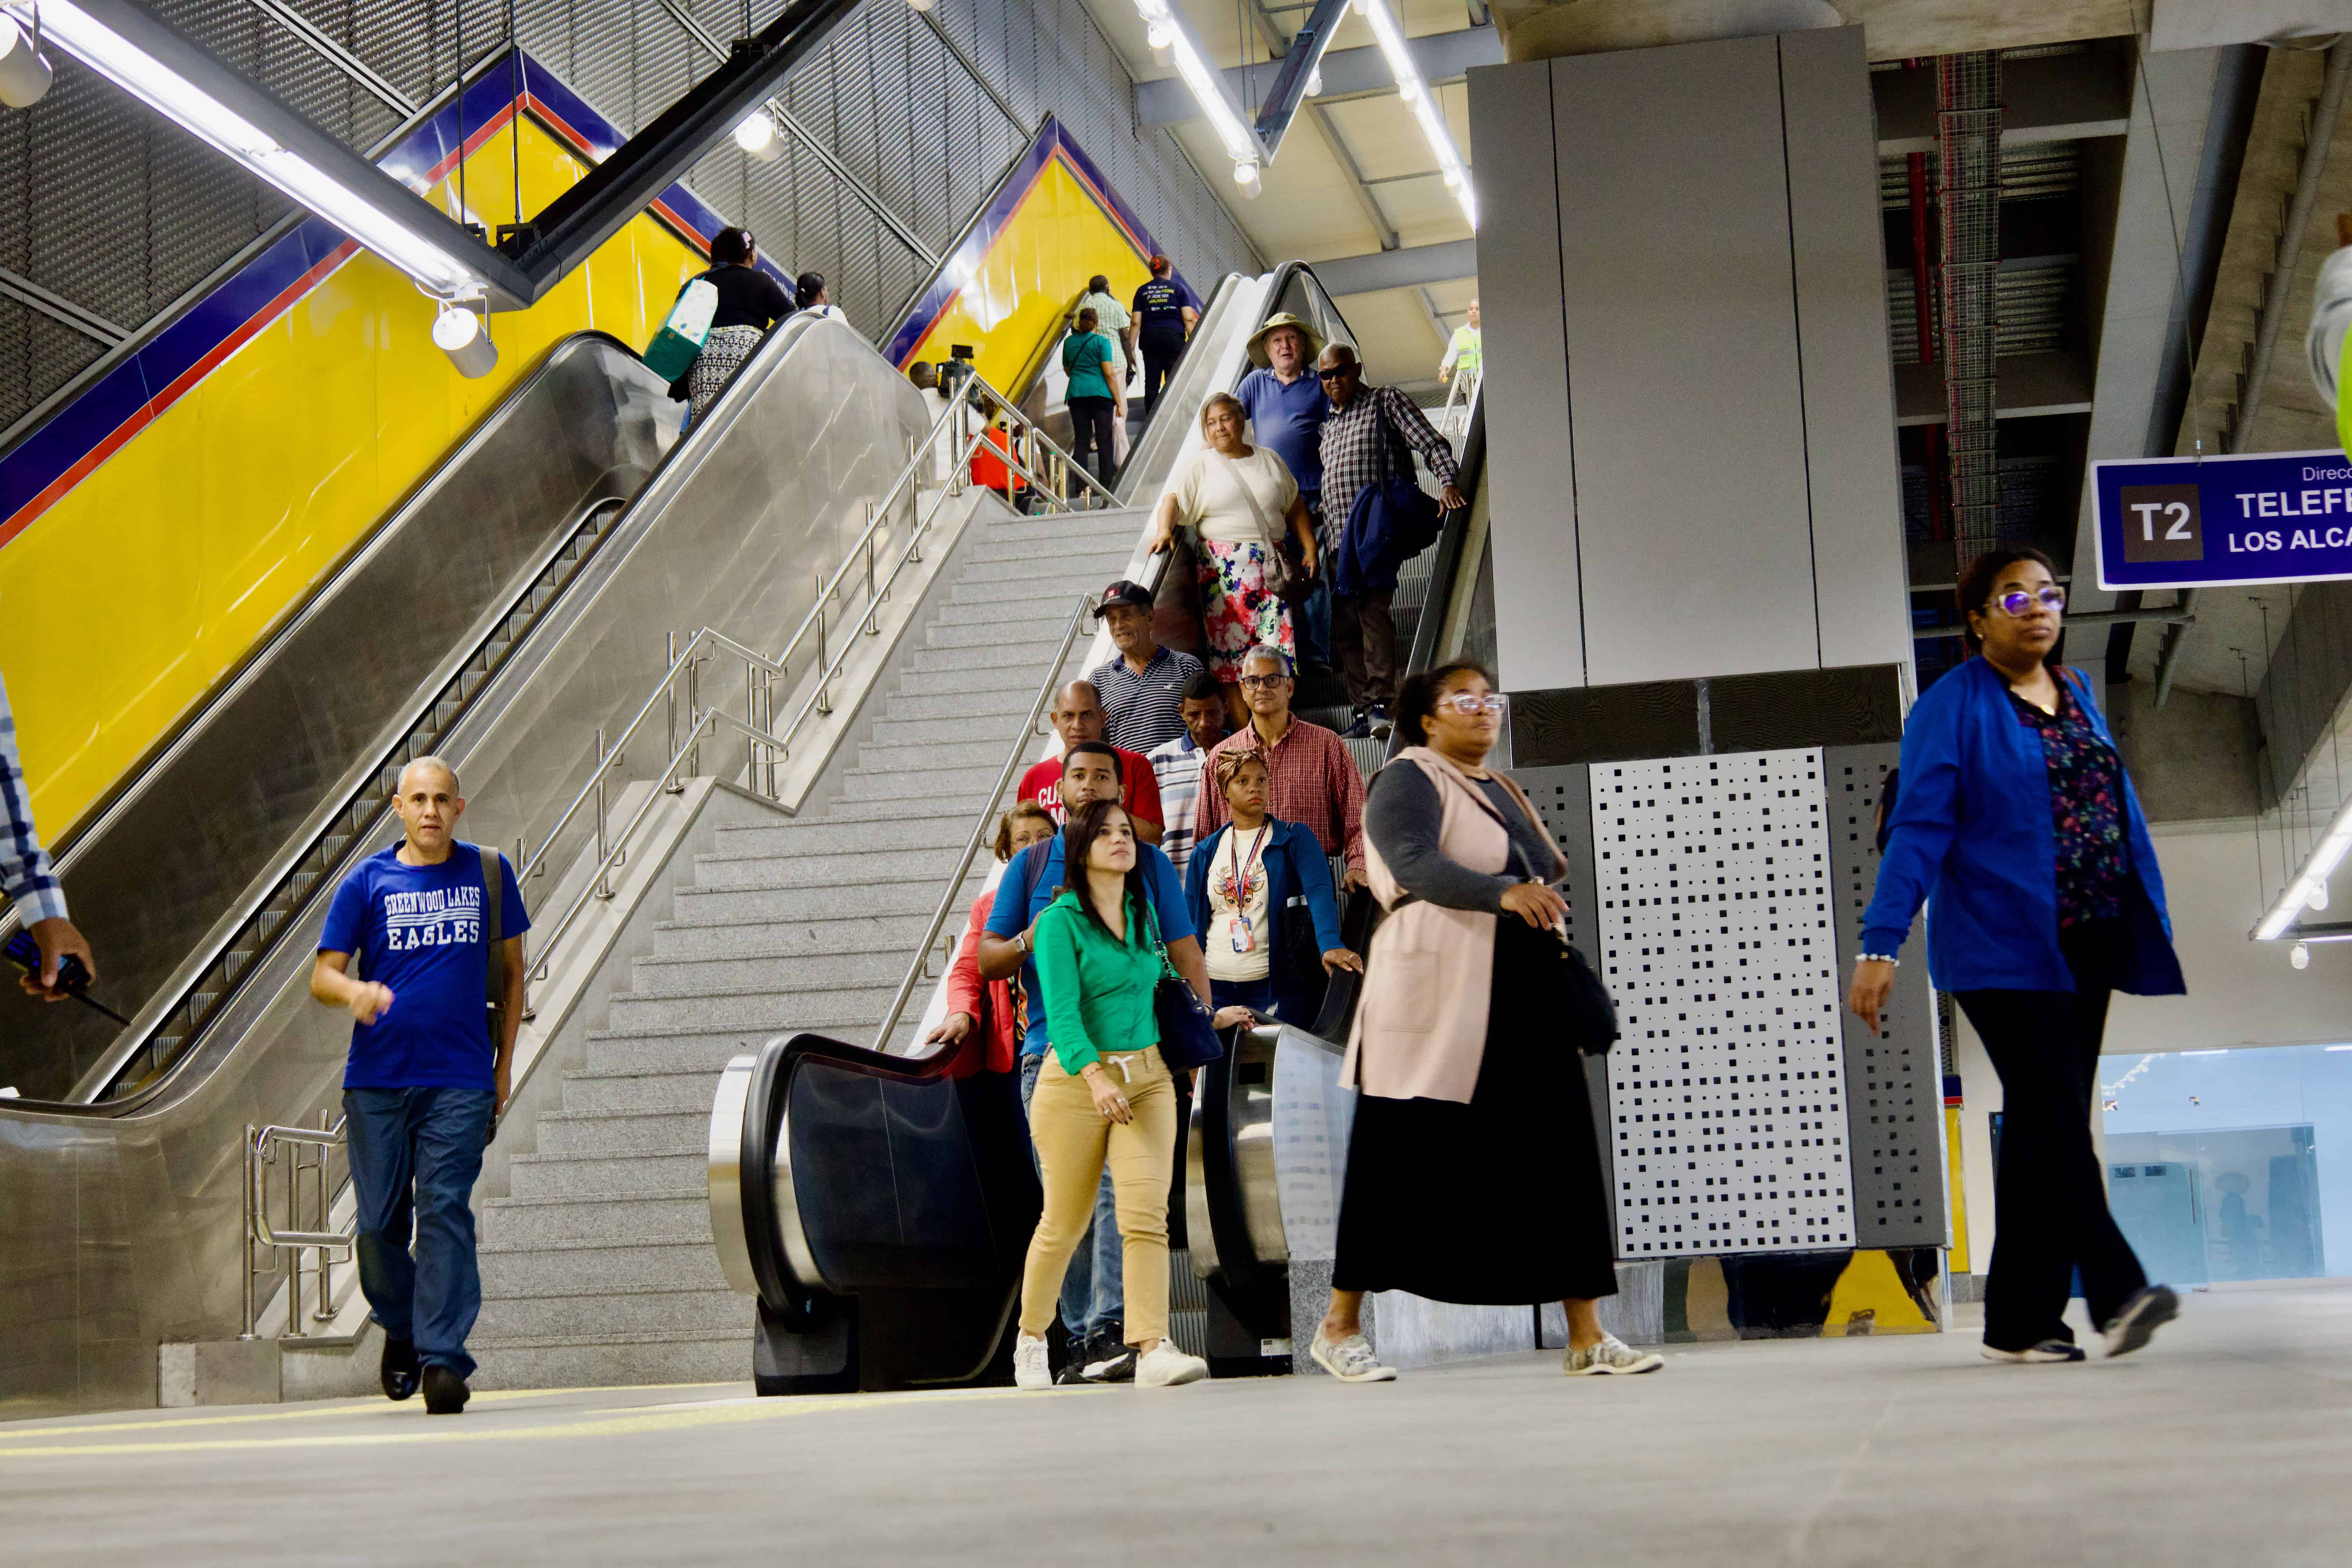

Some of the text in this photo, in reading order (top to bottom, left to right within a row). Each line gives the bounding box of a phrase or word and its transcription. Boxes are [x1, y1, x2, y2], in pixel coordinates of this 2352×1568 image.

[2131, 502, 2192, 541] T2
[2229, 531, 2282, 553] LOS
[384, 886, 480, 916] GREENWOOD LAKES
[387, 920, 480, 950] EAGLES
